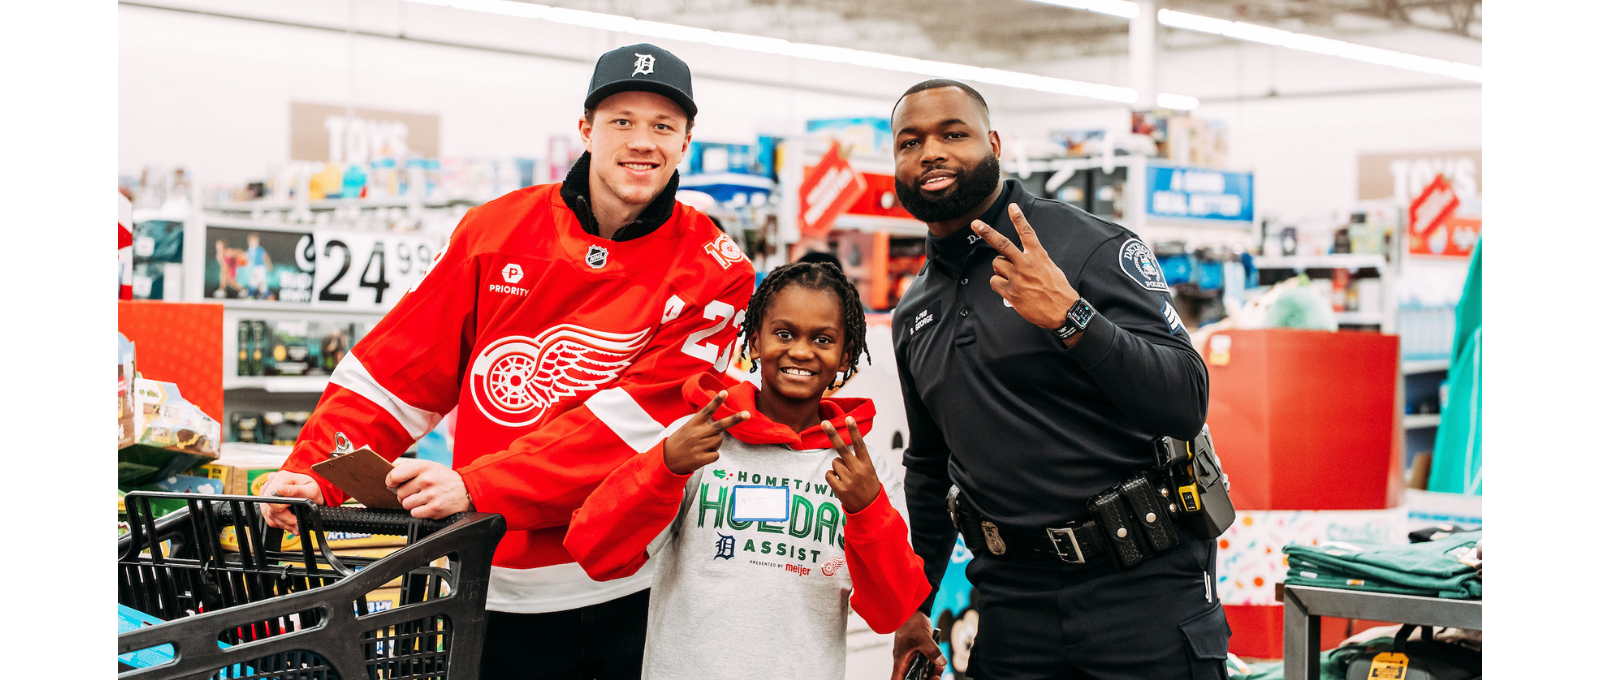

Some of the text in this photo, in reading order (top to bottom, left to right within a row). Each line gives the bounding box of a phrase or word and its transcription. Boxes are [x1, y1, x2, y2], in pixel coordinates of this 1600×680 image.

[631, 53, 656, 78] D
[324, 114, 409, 164] TOYS
[319, 239, 390, 304] 24
[489, 284, 530, 297] PRIORITY
[743, 539, 821, 563] ASSIST
[785, 563, 811, 577] meijer
